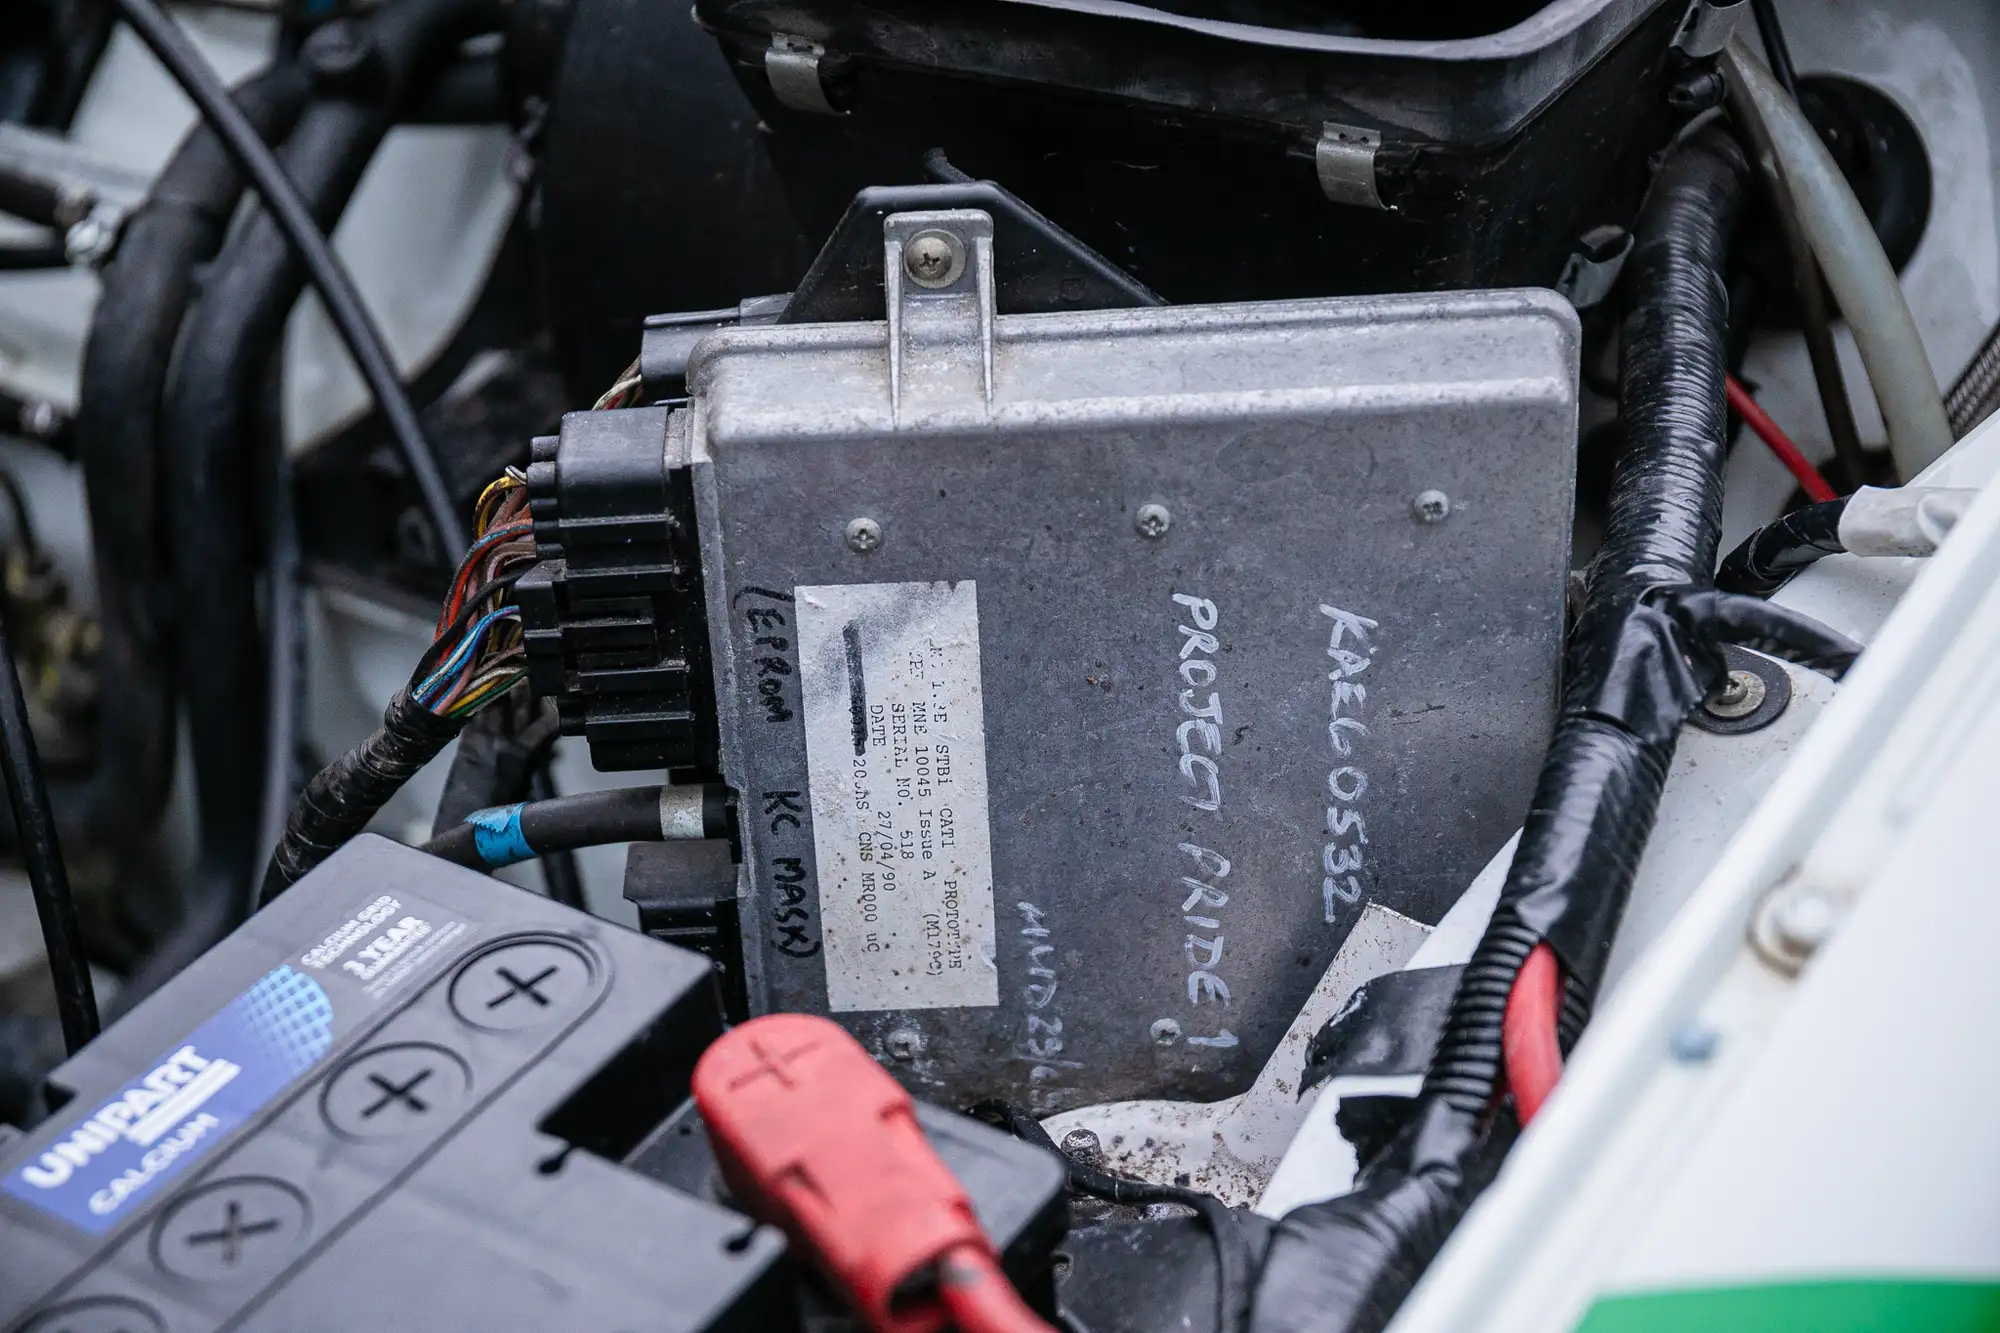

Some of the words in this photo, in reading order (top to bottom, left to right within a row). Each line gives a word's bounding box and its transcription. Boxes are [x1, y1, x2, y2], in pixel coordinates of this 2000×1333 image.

[870, 704, 886, 746] DATE
[911, 701, 928, 735] MNE
[1172, 593, 1224, 810] PROJECT
[891, 703, 909, 768] SERIAL
[900, 830, 914, 860] 518
[914, 746, 932, 797] 10045
[858, 832, 873, 862] CNS
[876, 811, 896, 891] 27/04/90
[918, 809, 934, 860] Issue
[923, 870, 936, 881] A
[357, 916, 425, 959] YEAR
[1178, 842, 1231, 1007] PRIDE
[21, 1045, 210, 1190] UNIPART
[89, 1112, 220, 1215] CALCIUM
